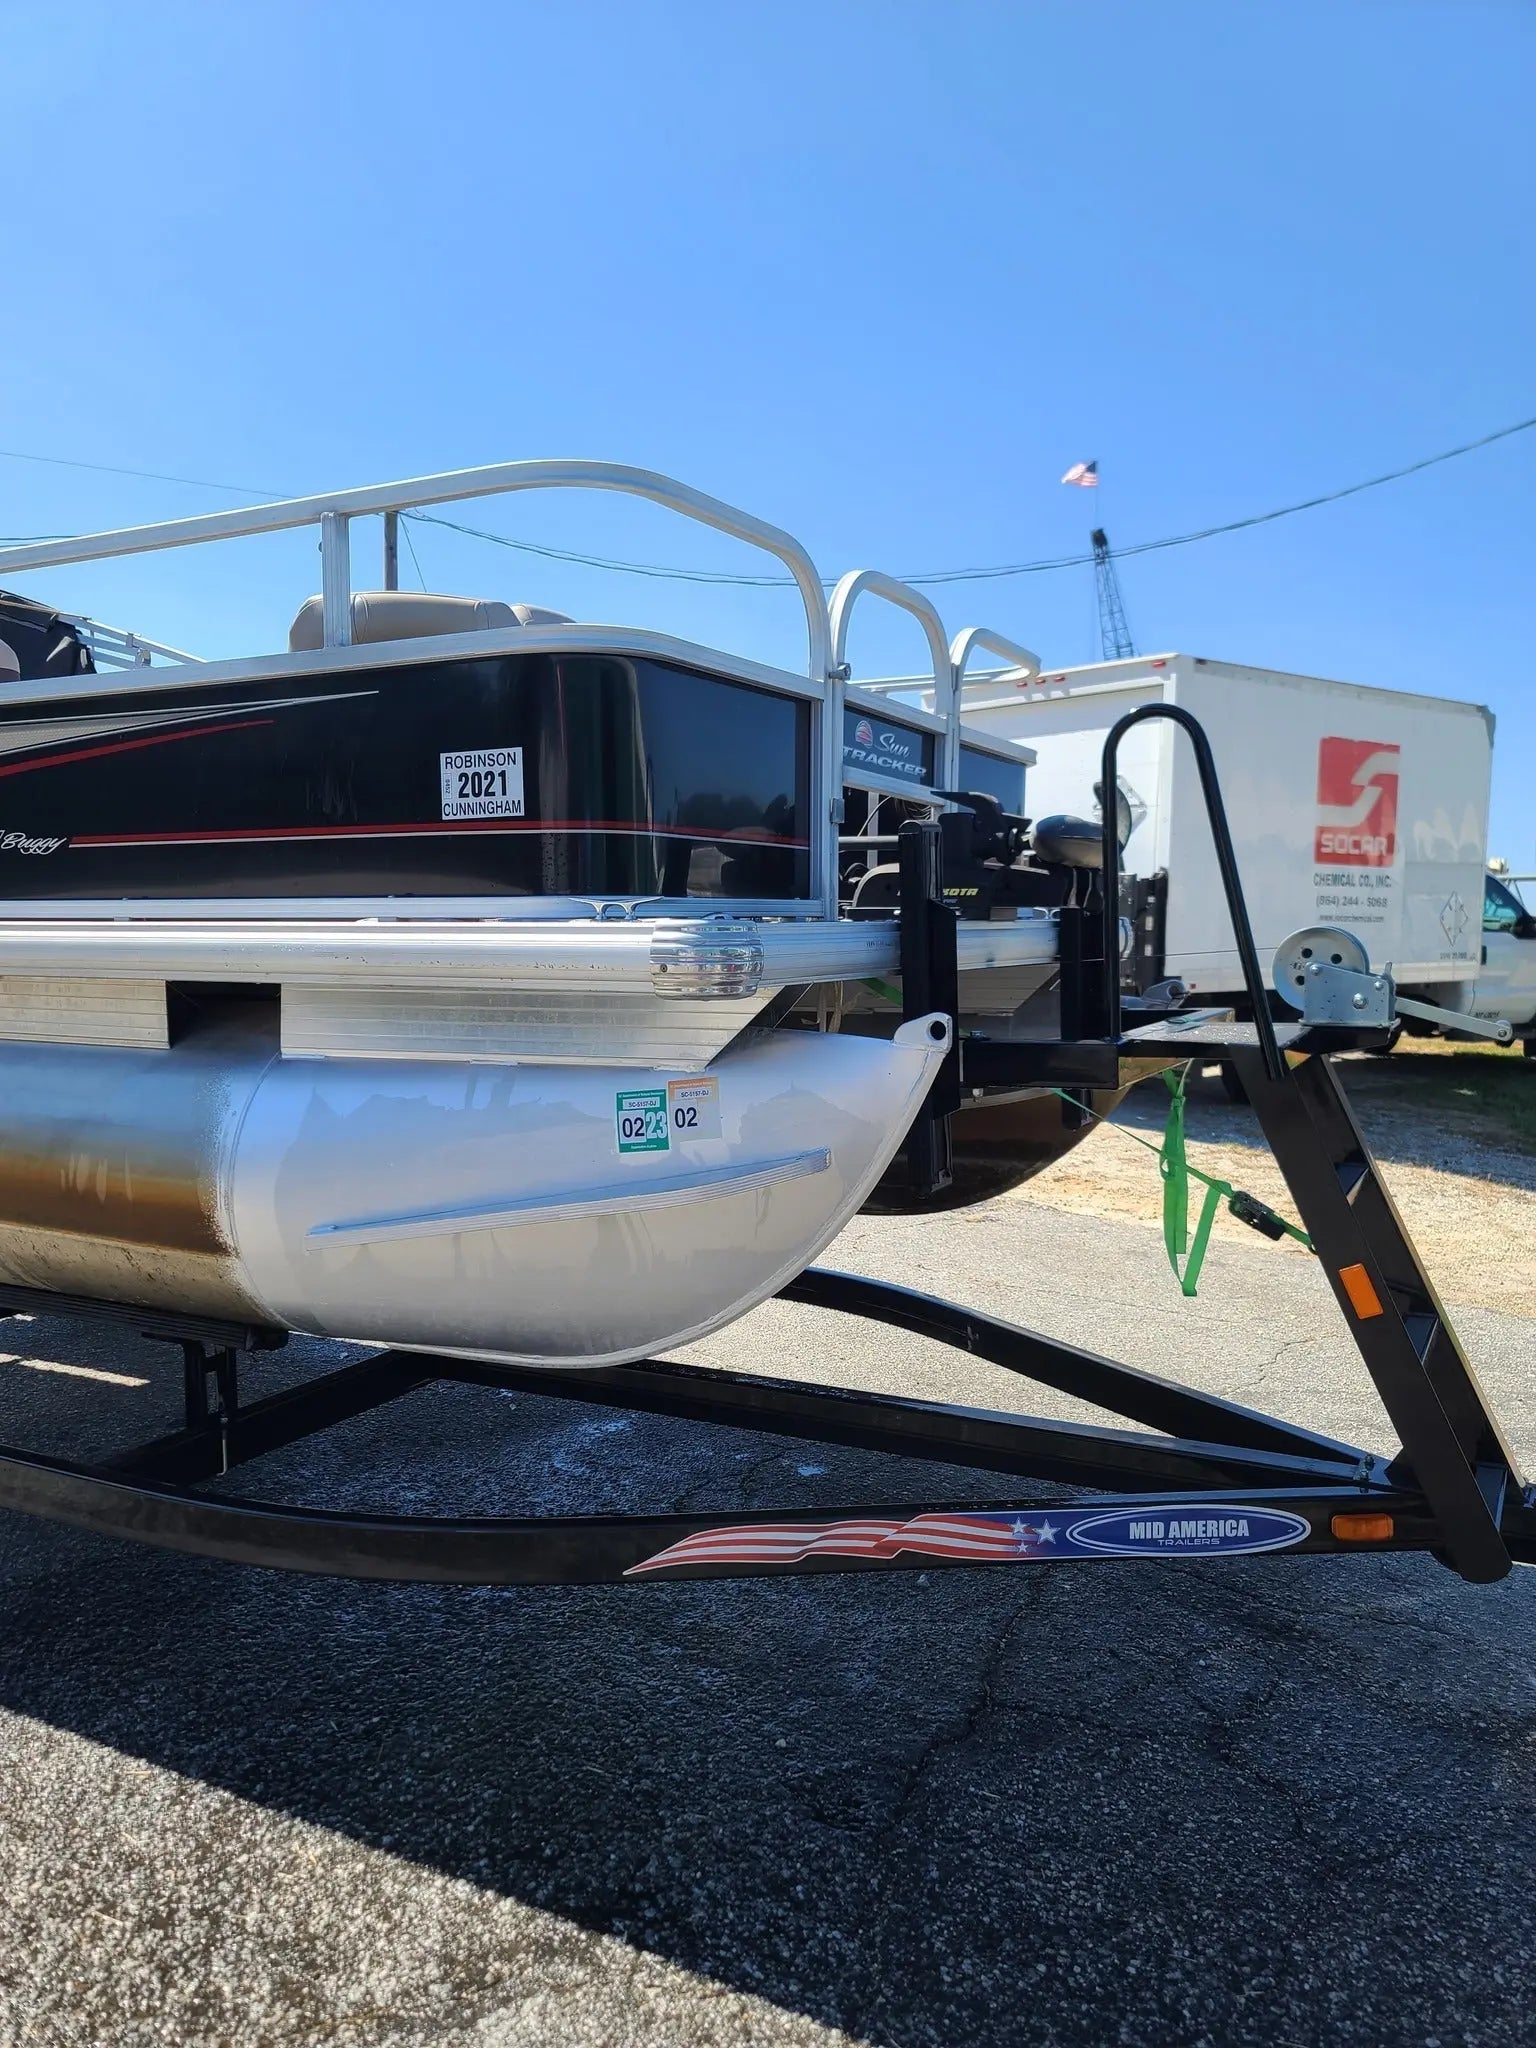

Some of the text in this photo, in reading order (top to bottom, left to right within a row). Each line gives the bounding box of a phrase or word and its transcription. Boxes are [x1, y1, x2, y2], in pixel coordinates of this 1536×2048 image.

[874, 733, 910, 758] Sun
[445, 752, 516, 769] ROBINSON
[843, 745, 927, 777] TRACKER
[458, 770, 507, 798] 2021
[443, 800, 521, 817] CUNNINGHAM
[1, 832, 67, 855] Buggy
[1320, 833, 1388, 856] SOCAR
[1313, 873, 1355, 887] CHEMICAL
[1376, 874, 1392, 888] INC.
[1342, 895, 1358, 907] 244
[622, 1111, 667, 1139] 02 23
[674, 1106, 698, 1128] 02
[1129, 1519, 1250, 1539] MID AMERICA
[1158, 1538, 1220, 1546] TRAILERS
